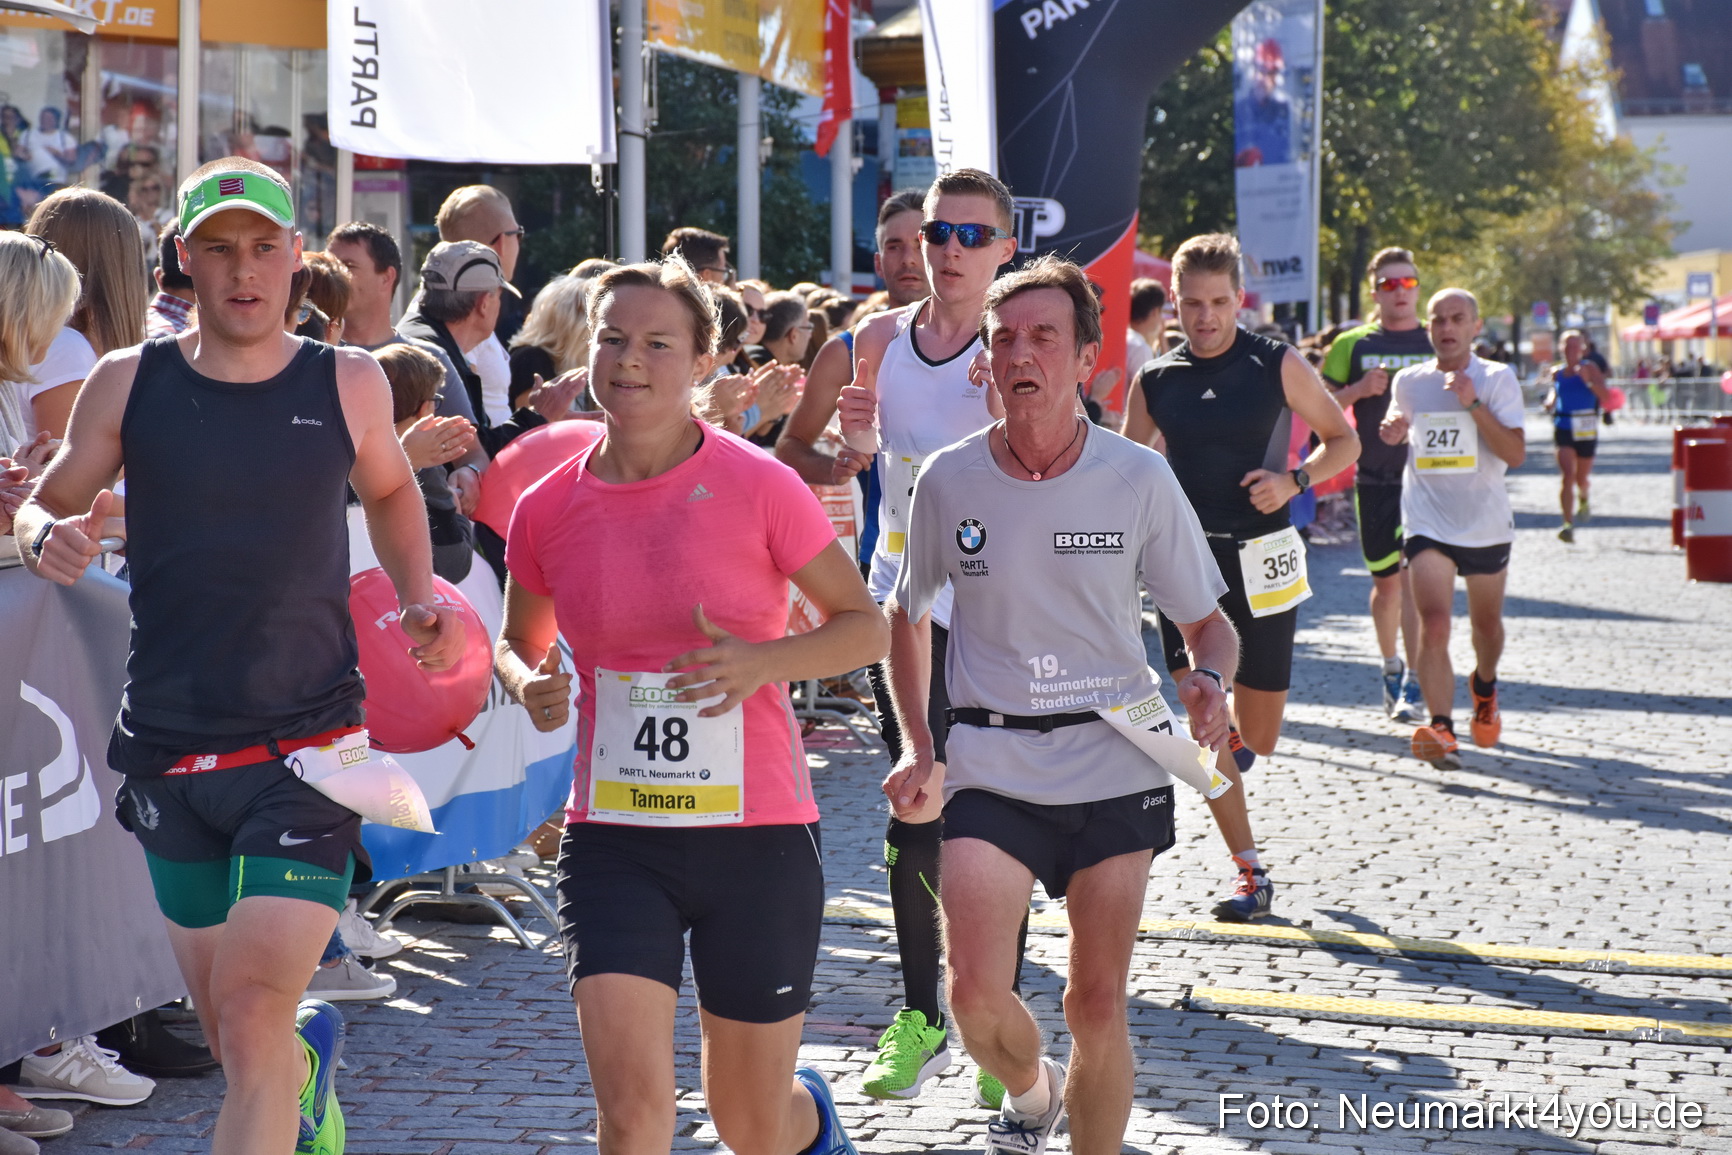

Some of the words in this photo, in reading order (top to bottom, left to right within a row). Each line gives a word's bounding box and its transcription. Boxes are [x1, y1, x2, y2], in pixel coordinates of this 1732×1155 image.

[1426, 429, 1460, 448] 247
[1054, 532, 1124, 549] BOCK
[960, 560, 988, 571] PARTL
[1263, 549, 1298, 580] 356
[1028, 654, 1068, 679] 19.
[1029, 676, 1114, 693] Neumarkter
[630, 686, 697, 703] BOC
[1031, 691, 1100, 710] Stadtlauf
[633, 716, 690, 762] 48
[619, 767, 647, 777] PARTL
[649, 769, 696, 779] Neumarkt
[630, 788, 696, 809] Tamara
[1150, 795, 1167, 806] asic
[0, 771, 28, 857] E
